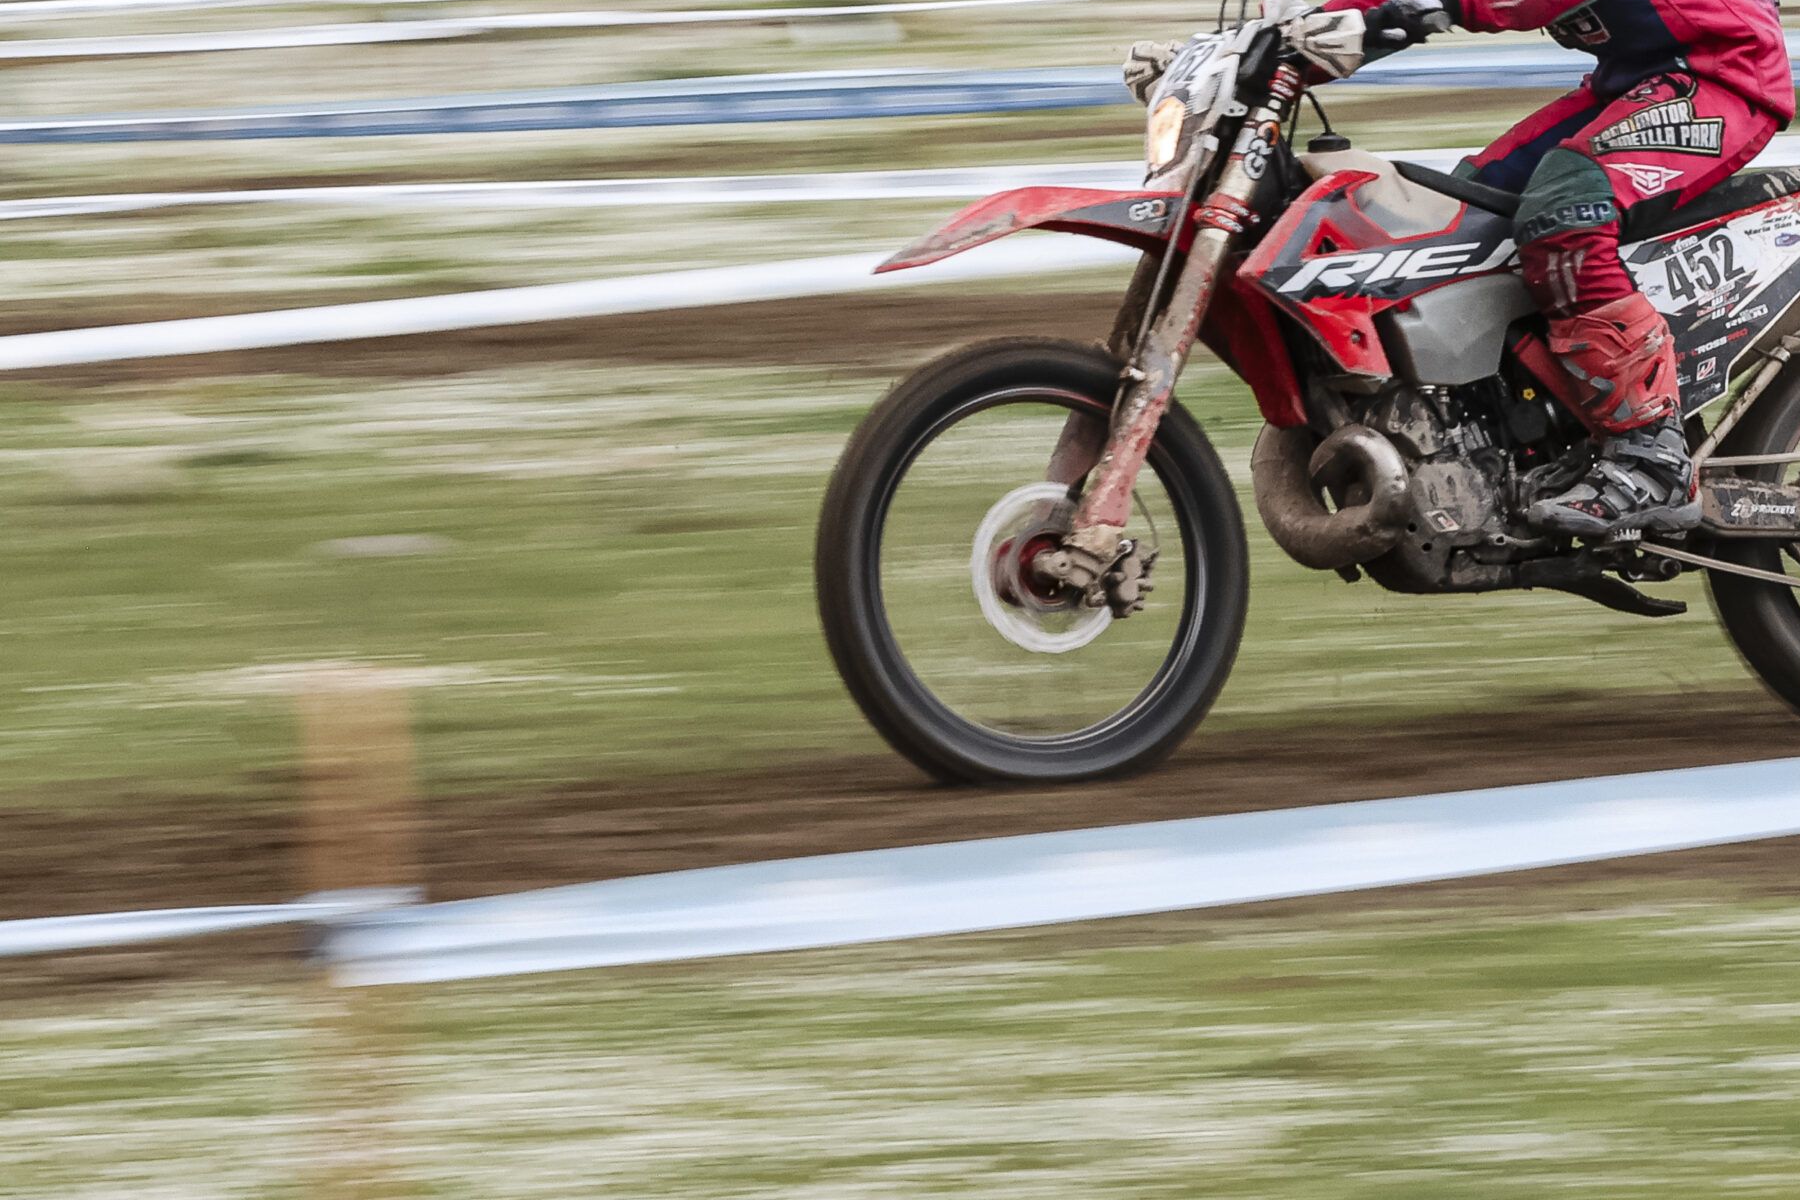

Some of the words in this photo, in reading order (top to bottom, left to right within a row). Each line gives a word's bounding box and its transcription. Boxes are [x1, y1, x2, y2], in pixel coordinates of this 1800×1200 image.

[1634, 101, 1690, 131] MOTOR
[1680, 123, 1719, 149] PARK
[1277, 238, 1523, 292] RIEJ
[1664, 233, 1745, 301] 452
